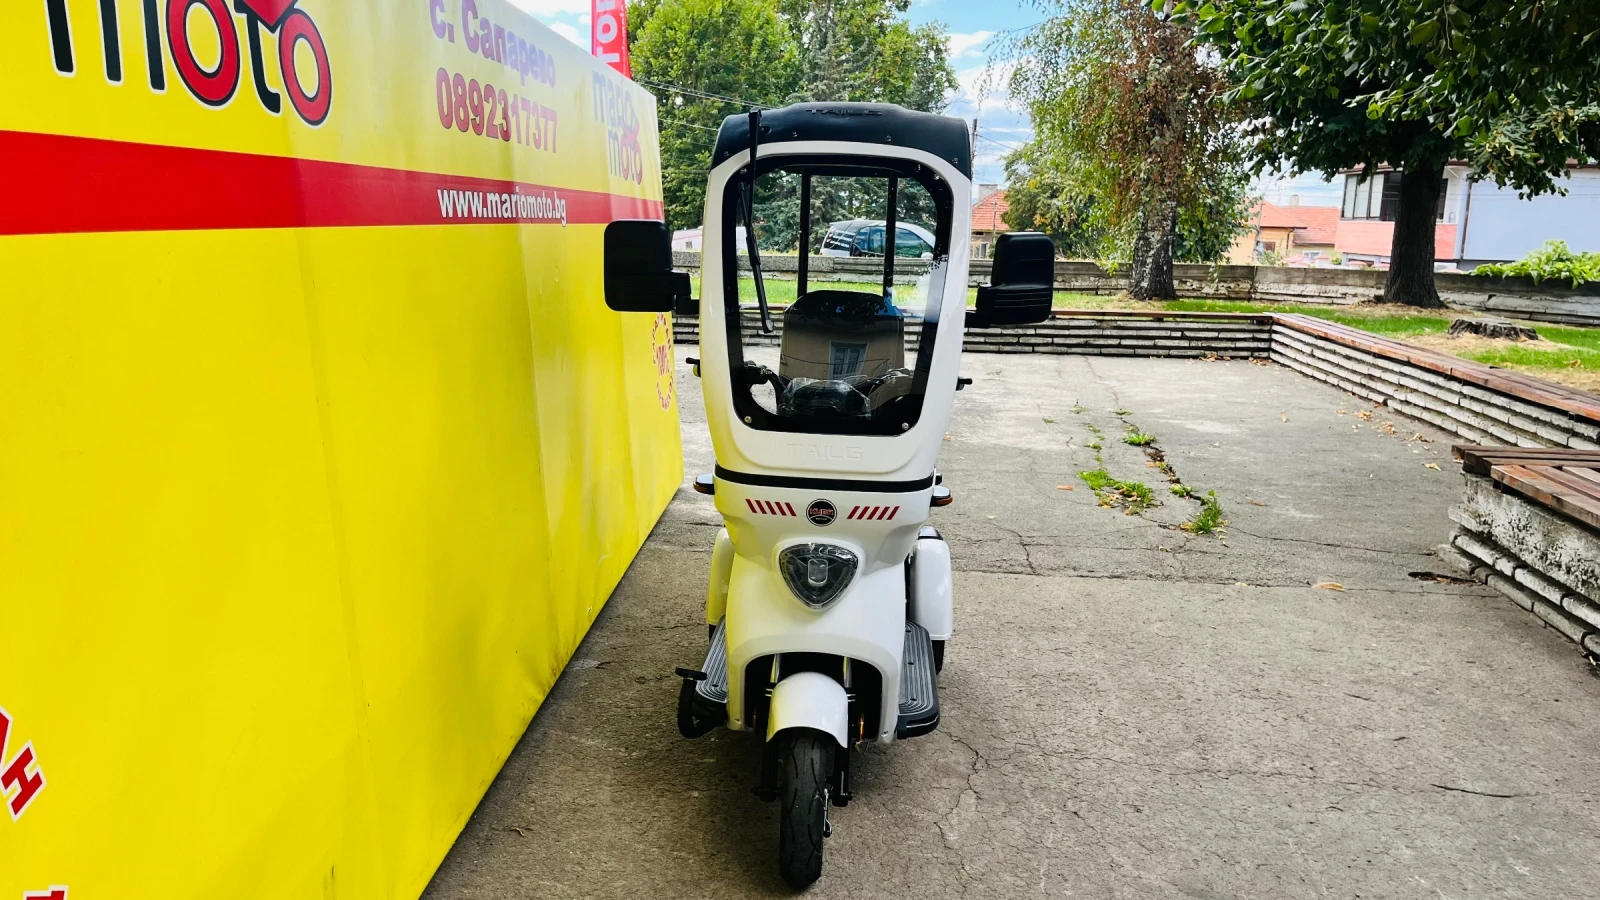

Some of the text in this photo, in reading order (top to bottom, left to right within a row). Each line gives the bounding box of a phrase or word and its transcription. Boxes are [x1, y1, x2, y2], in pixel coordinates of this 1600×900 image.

[436, 67, 558, 154] 0892317377
[592, 70, 635, 131] mario
[608, 129, 643, 186] moto
[437, 185, 567, 228] www.mariomoto.bg
[785, 443, 864, 461] TAILG
